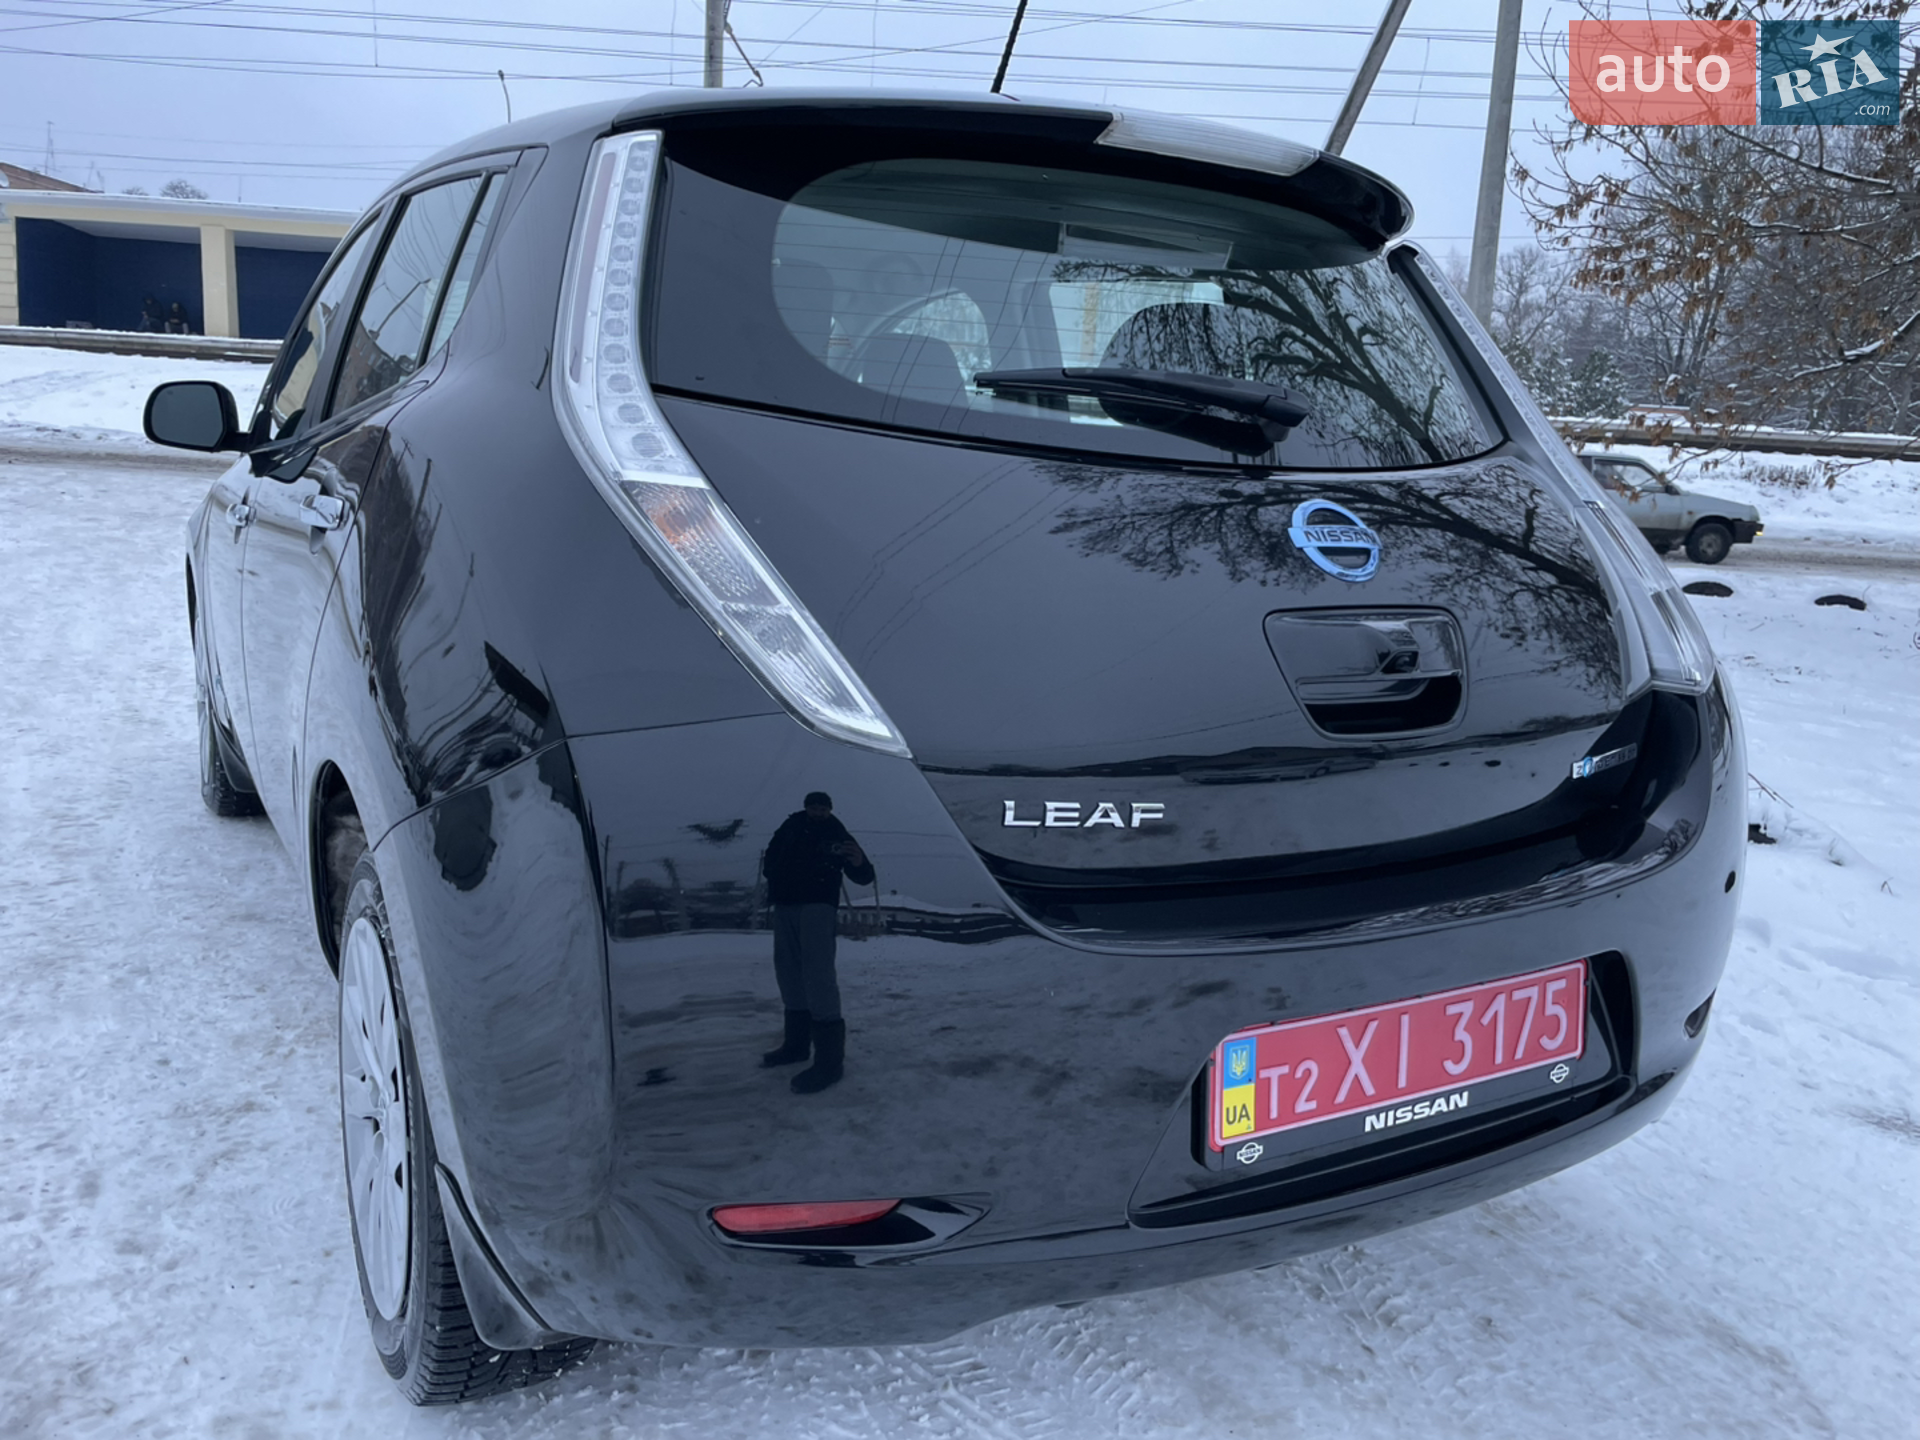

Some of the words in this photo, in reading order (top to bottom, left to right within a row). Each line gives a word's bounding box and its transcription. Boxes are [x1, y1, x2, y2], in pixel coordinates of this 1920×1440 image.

[1304, 529, 1376, 543] NISSAN
[1003, 800, 1166, 828] LEAF
[1443, 978, 1568, 1076] 3175
[1226, 1103, 1251, 1126] UA
[1364, 1090, 1469, 1133] NISSAN
